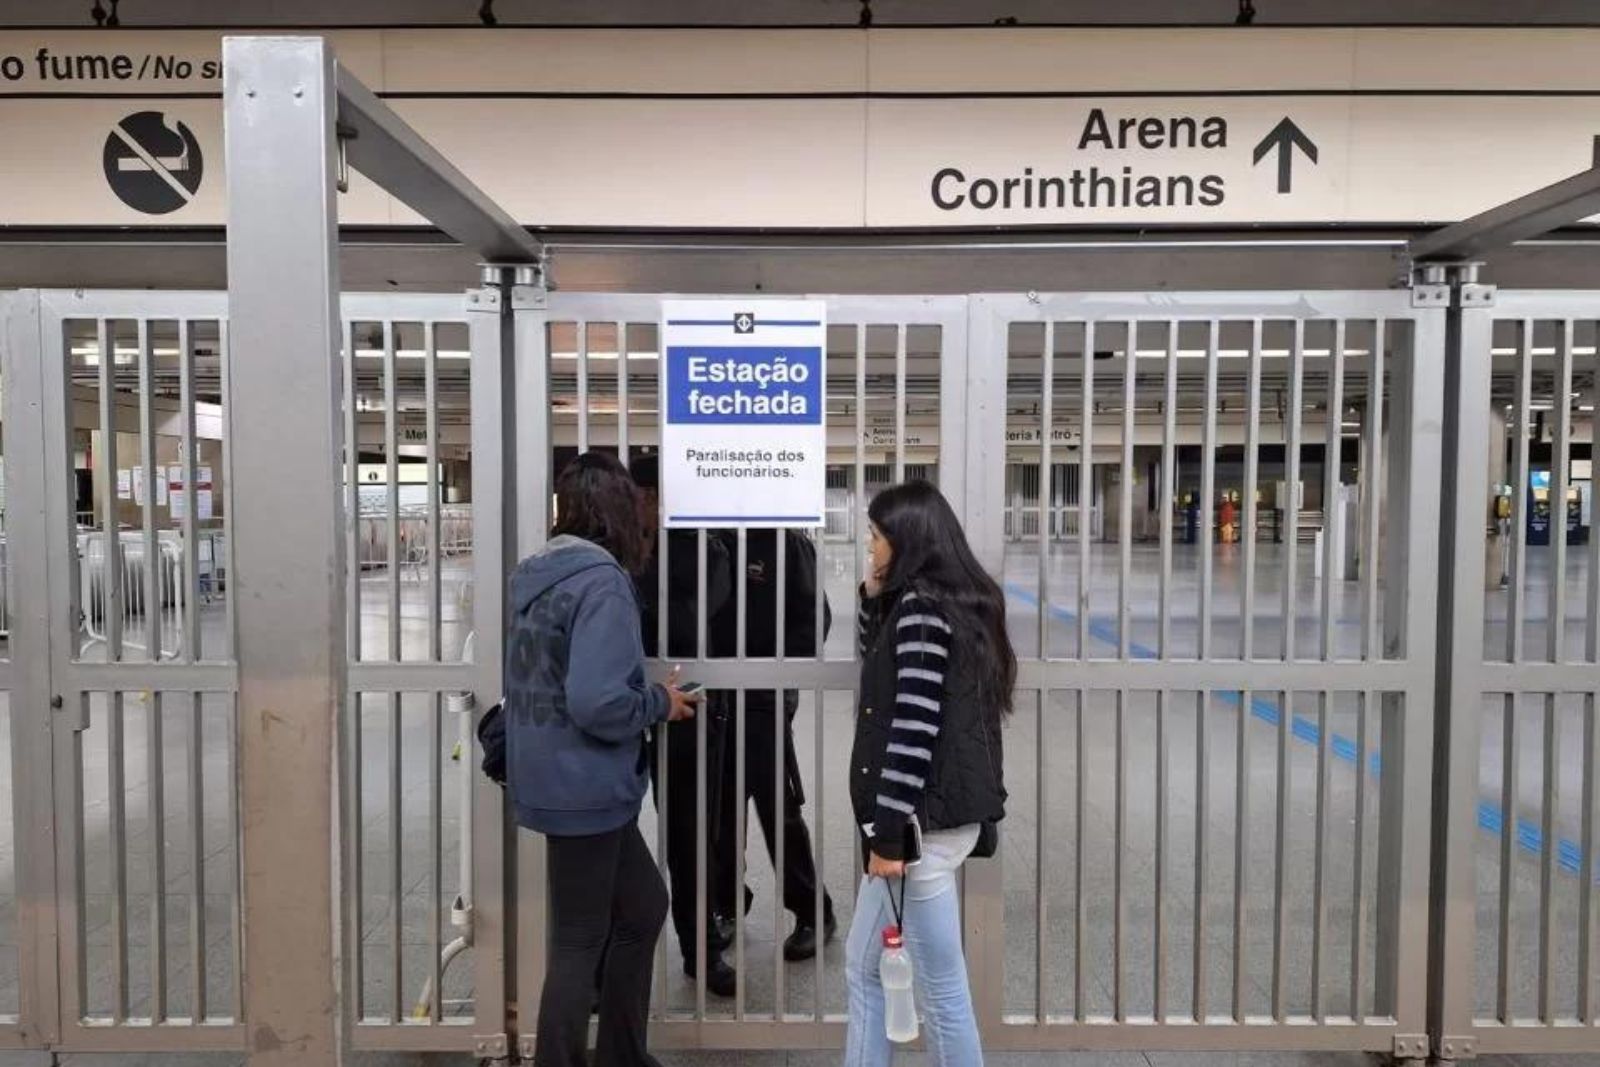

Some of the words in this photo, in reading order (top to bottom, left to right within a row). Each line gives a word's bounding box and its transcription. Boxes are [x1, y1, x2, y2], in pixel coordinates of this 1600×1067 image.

[1077, 107, 1228, 150] Arena
[931, 166, 1225, 211] Corinthians
[688, 356, 808, 389] Estação
[687, 389, 808, 415] fechada
[686, 448, 772, 464] Paralisação
[777, 449, 805, 462] dos
[696, 464, 795, 478] funcionários.
